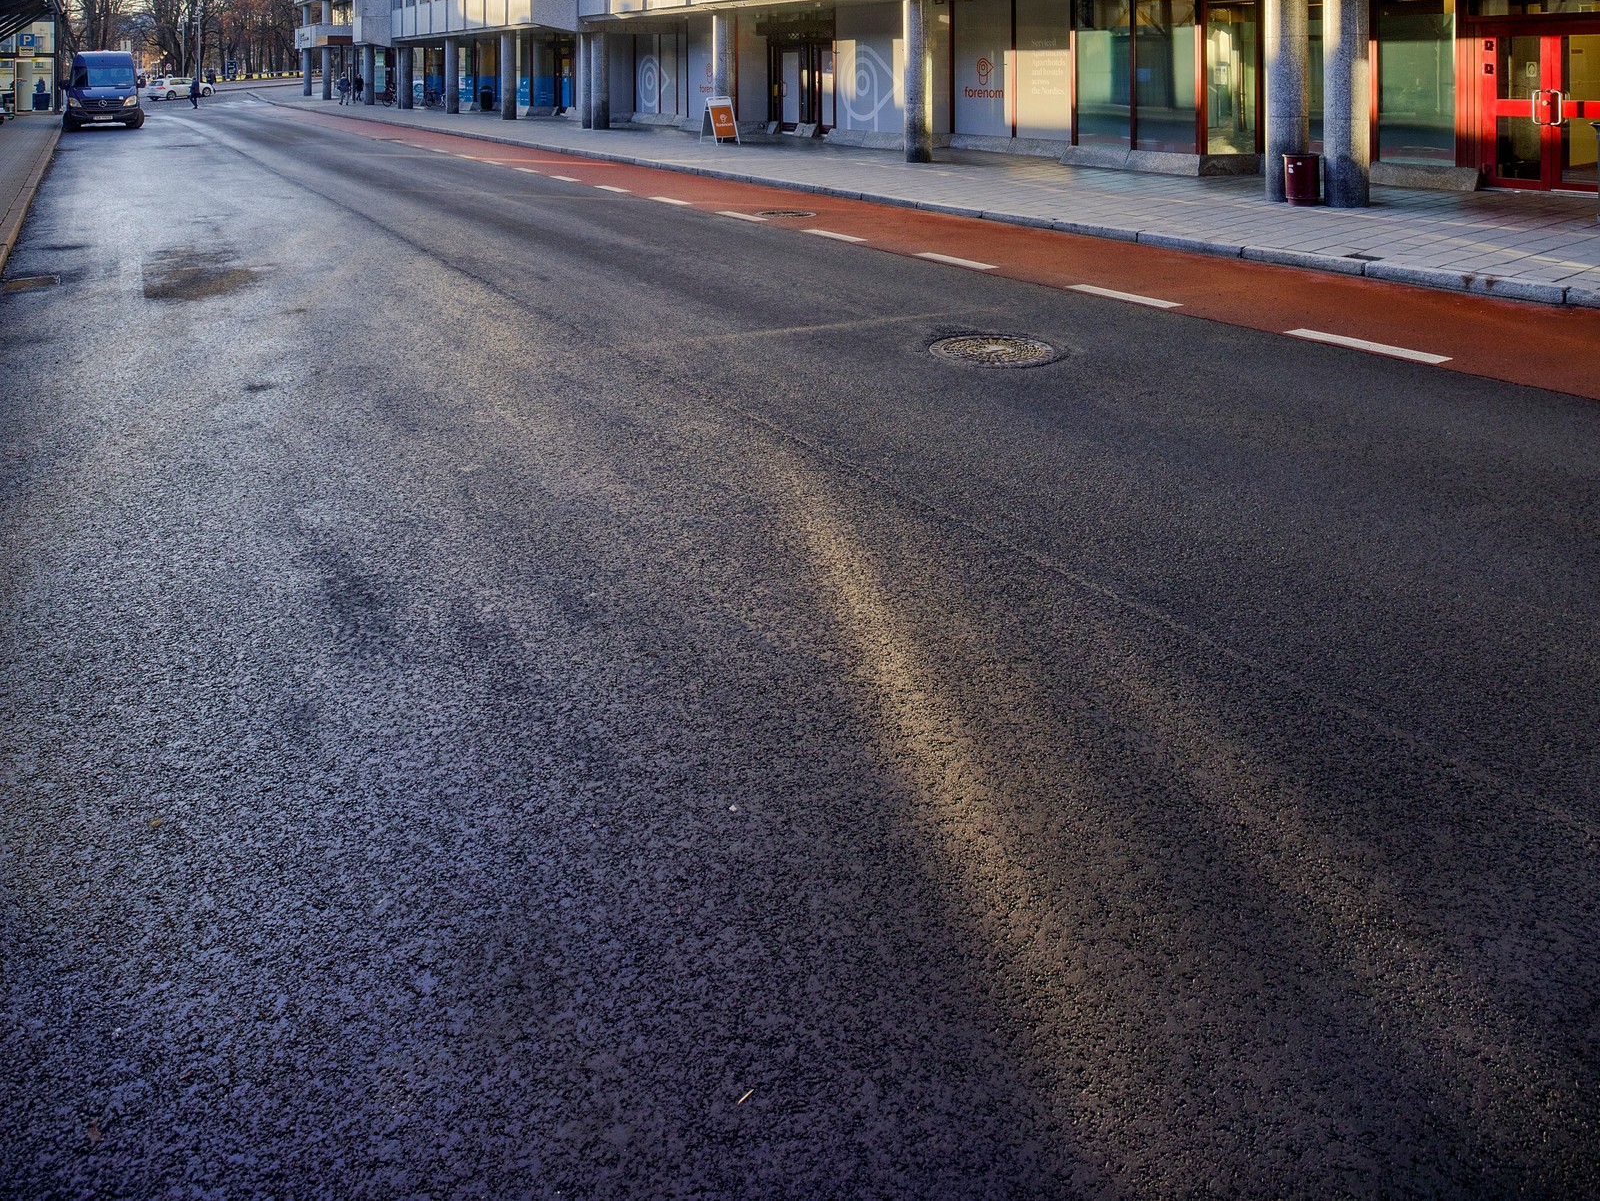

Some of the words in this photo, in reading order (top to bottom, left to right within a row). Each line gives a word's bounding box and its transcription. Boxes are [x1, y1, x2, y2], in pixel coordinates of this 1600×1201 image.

[23, 35, 32, 45] P
[699, 84, 713, 93] foren
[964, 86, 1004, 98] forenom
